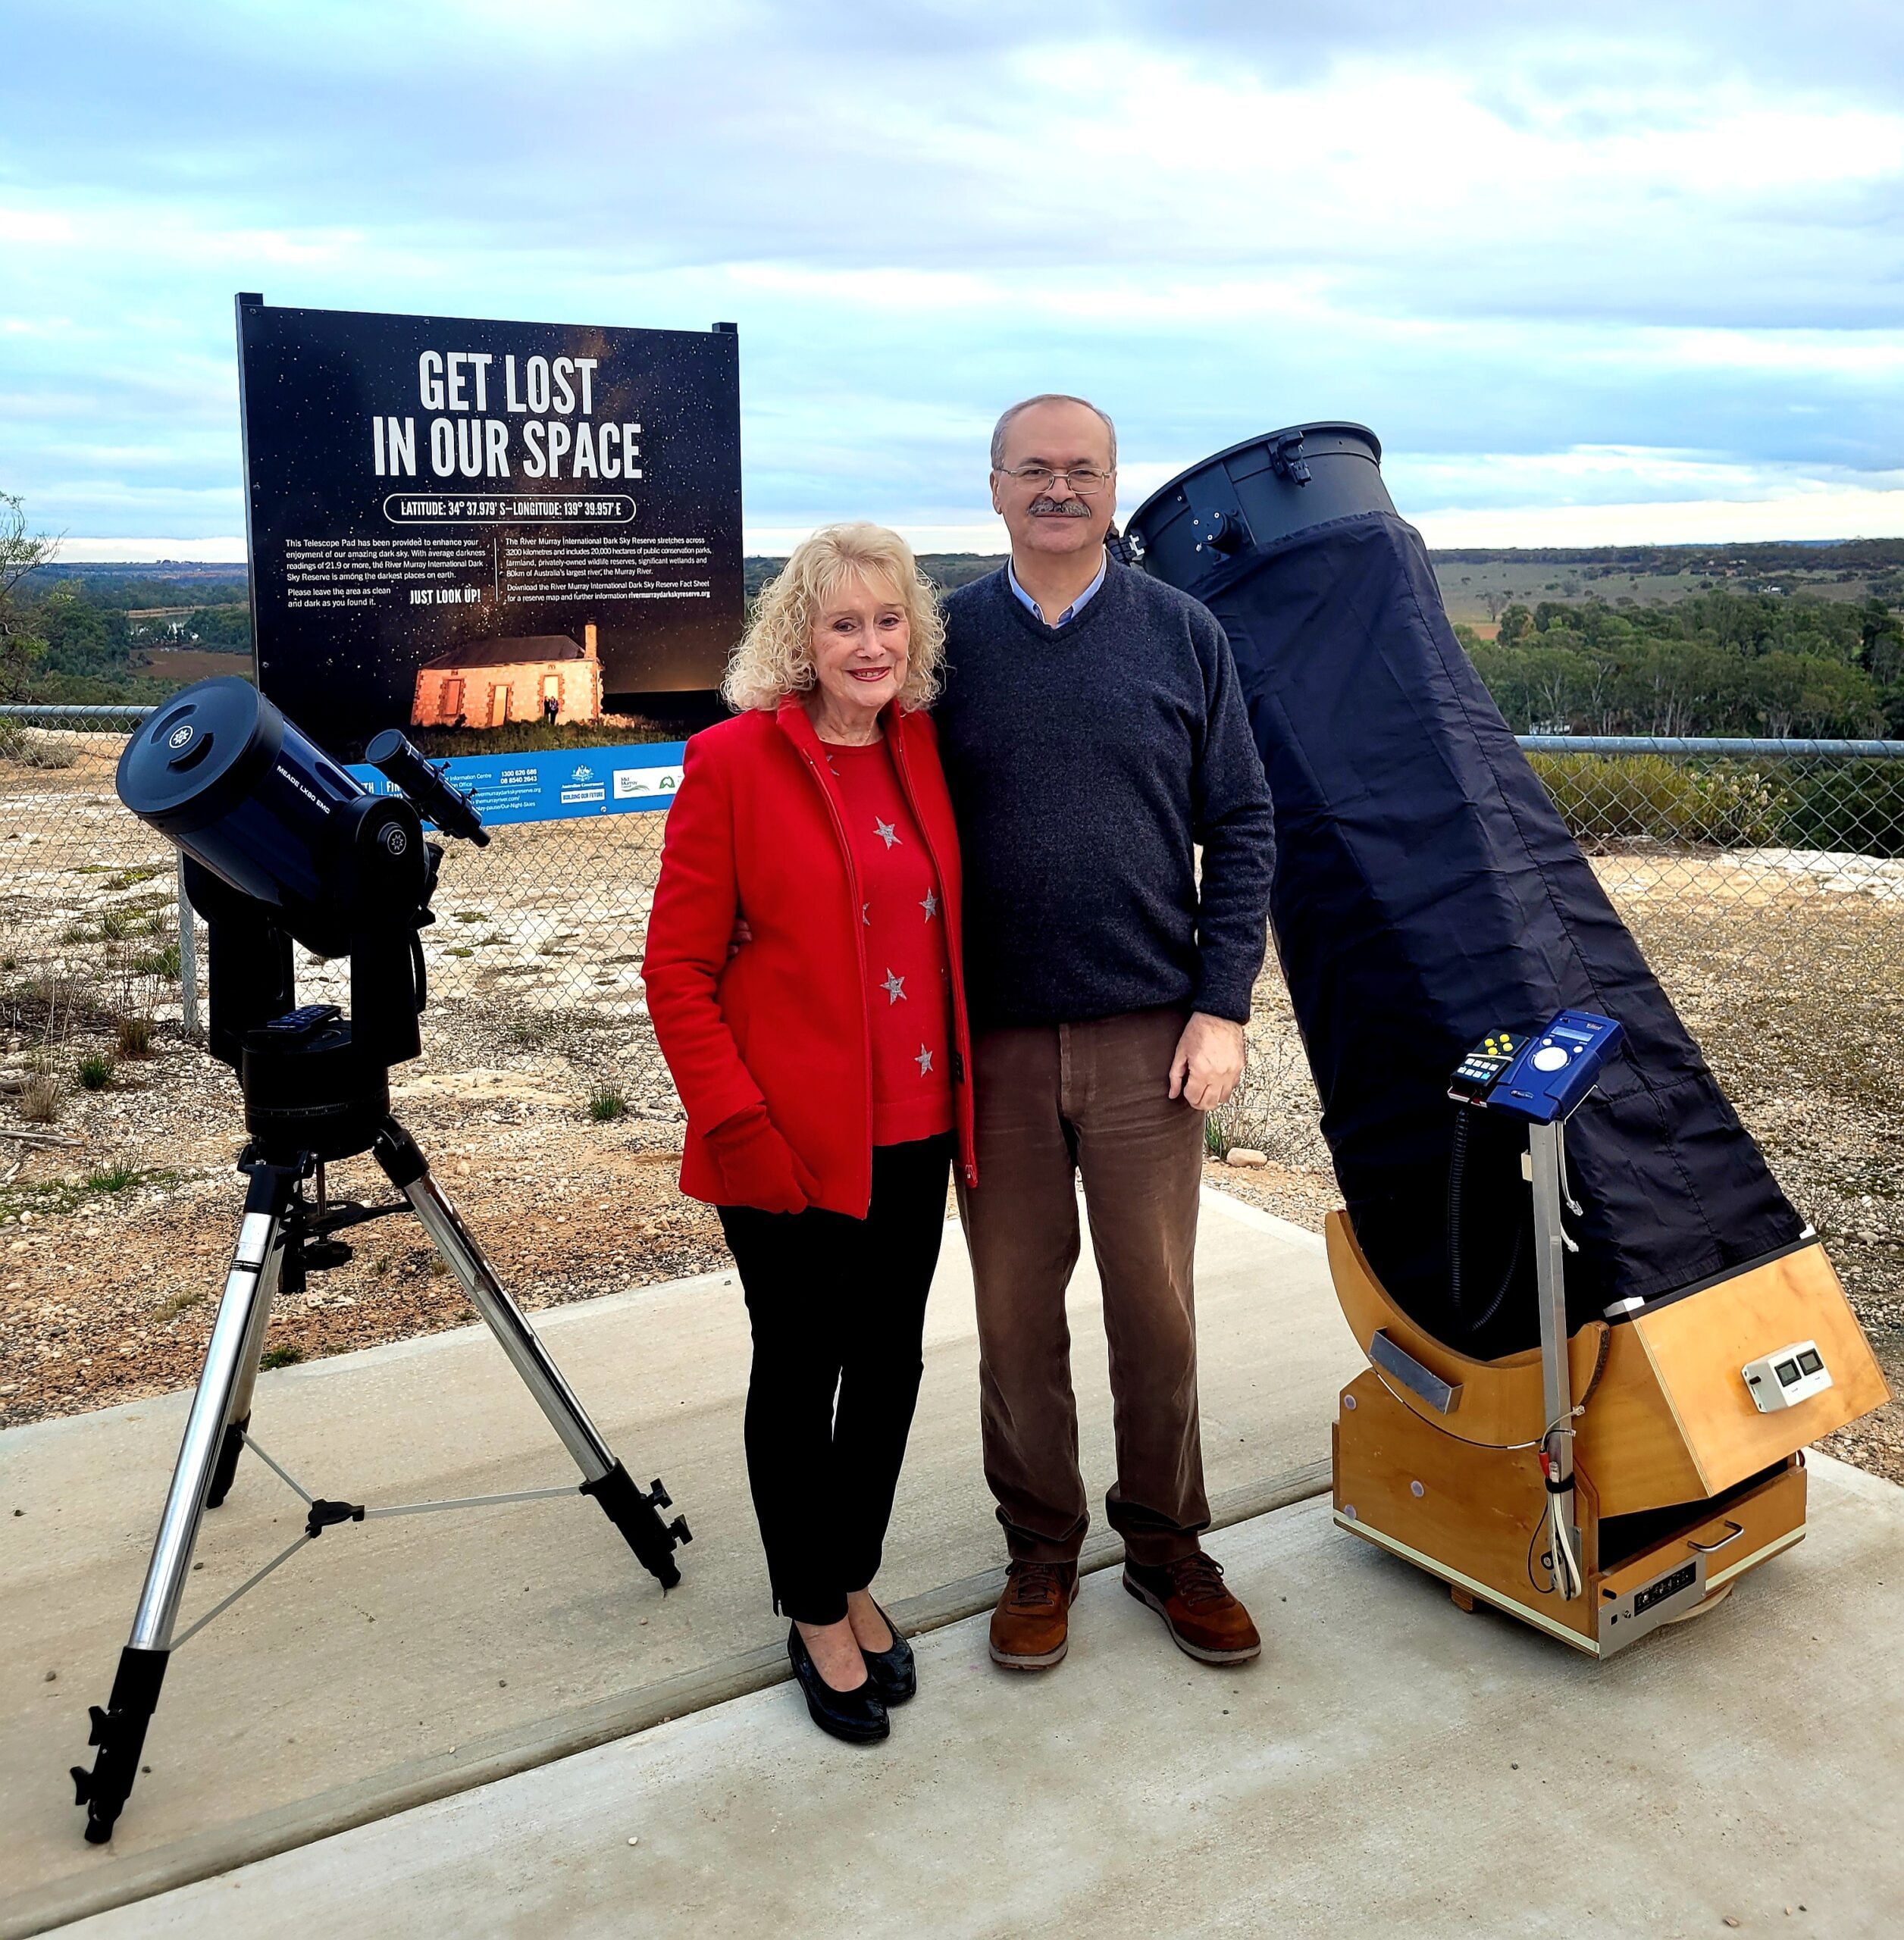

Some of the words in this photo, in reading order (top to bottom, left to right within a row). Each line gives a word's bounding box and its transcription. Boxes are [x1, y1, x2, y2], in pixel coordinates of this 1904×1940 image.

[419, 350, 492, 411] GET
[506, 355, 597, 415] LOST
[373, 416, 416, 476] IN
[431, 418, 510, 477] OUR
[523, 421, 642, 479] SPACE
[401, 502, 446, 515] LATITUDE:
[448, 501, 465, 515] 34°
[564, 502, 583, 515] 139°
[616, 502, 621, 515] E
[303, 539, 339, 548] Telescope
[393, 538, 421, 547] provided
[539, 537, 561, 546] Murray
[619, 537, 631, 546] Sky
[287, 550, 323, 560] enjoyment
[348, 550, 377, 559] amazing
[396, 550, 409, 559] sky.
[506, 548, 521, 556] 3200
[644, 547, 659, 555] public
[287, 562, 315, 570] readings
[318, 561, 324, 569] of
[403, 561, 426, 569] Murray
[539, 559, 586, 568] privately-owned
[639, 557, 668, 566] significant
[287, 574, 300, 582] Sky
[404, 571, 425, 580] places
[566, 569, 586, 577] largest
[615, 568, 635, 577] Murray
[507, 583, 537, 591] Download
[568, 583, 589, 591] Murray
[644, 581, 654, 590] Sky
[410, 590, 433, 605] JUST
[437, 589, 462, 604] LOOK
[465, 589, 481, 603] UP!
[277, 765, 299, 788] MEADE
[315, 799, 330, 814] EMC
